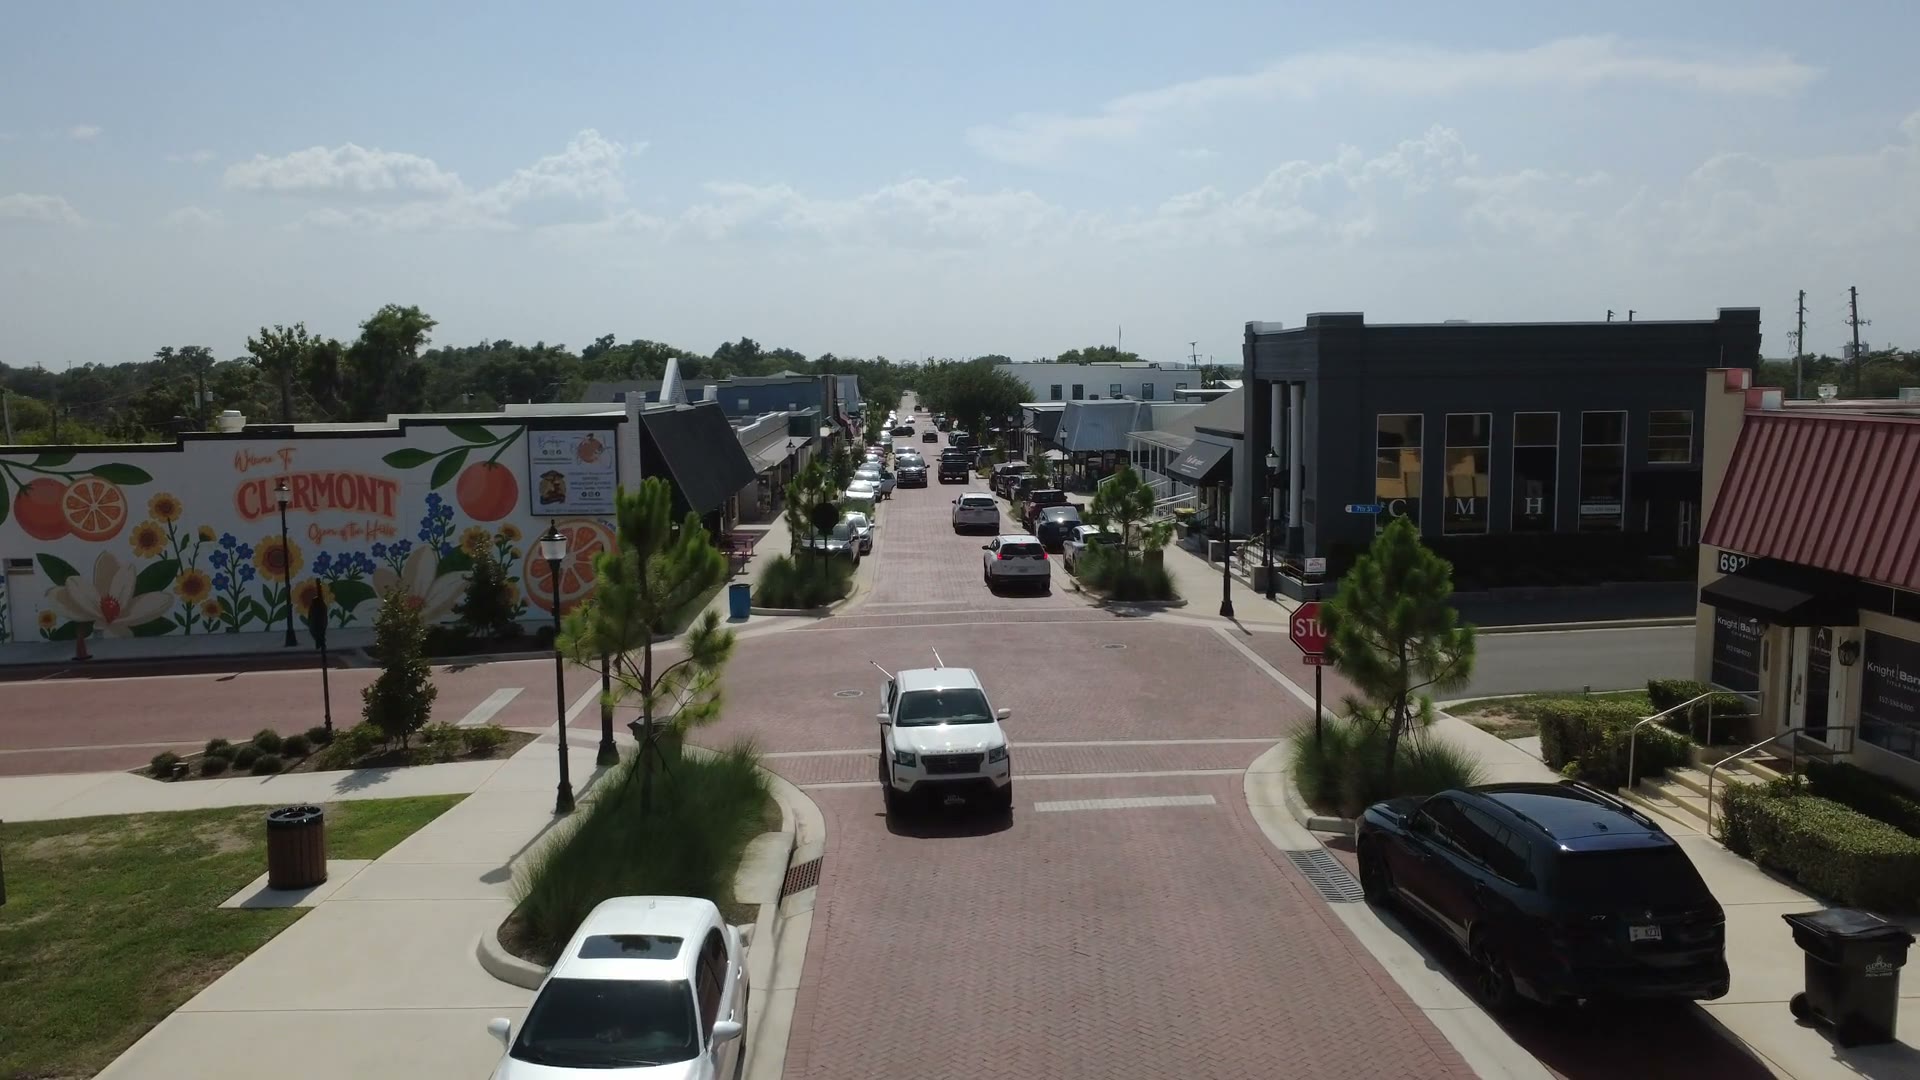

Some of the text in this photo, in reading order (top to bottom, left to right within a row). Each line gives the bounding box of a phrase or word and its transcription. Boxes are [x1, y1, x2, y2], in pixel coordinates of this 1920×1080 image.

[1389, 497, 1543, 517] C M H
[1295, 618, 1328, 638] STO
[1717, 616, 1738, 630] Knight
[1817, 628, 1825, 640] A
[1867, 661, 1895, 678] Knight
